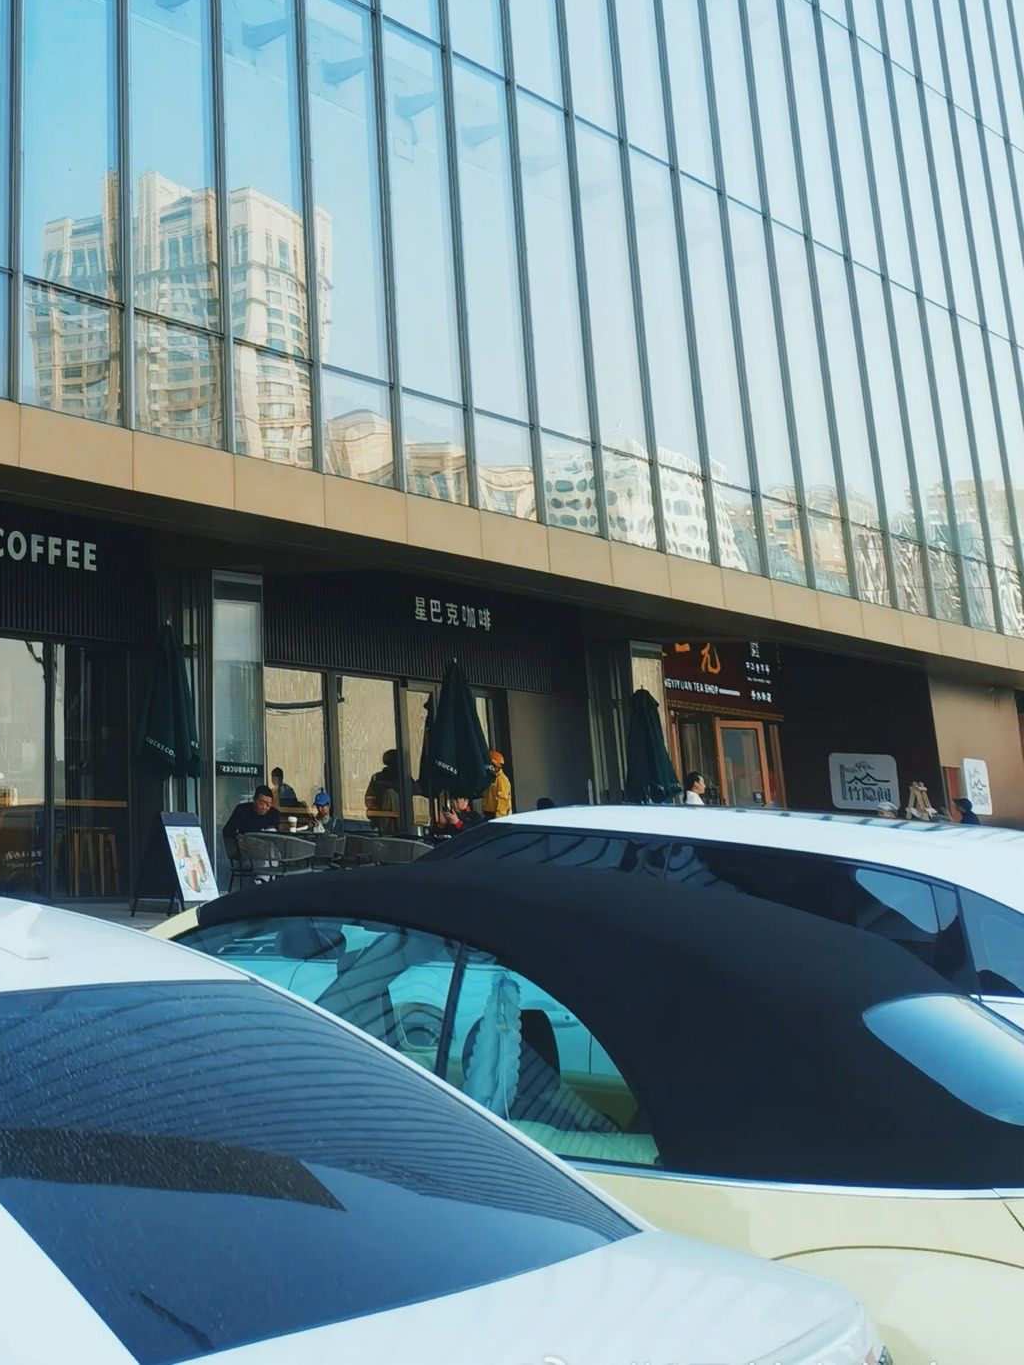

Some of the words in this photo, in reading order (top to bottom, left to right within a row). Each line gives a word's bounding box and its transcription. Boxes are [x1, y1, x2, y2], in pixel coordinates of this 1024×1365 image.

[415, 596, 491, 631] 星巴克咖啡
